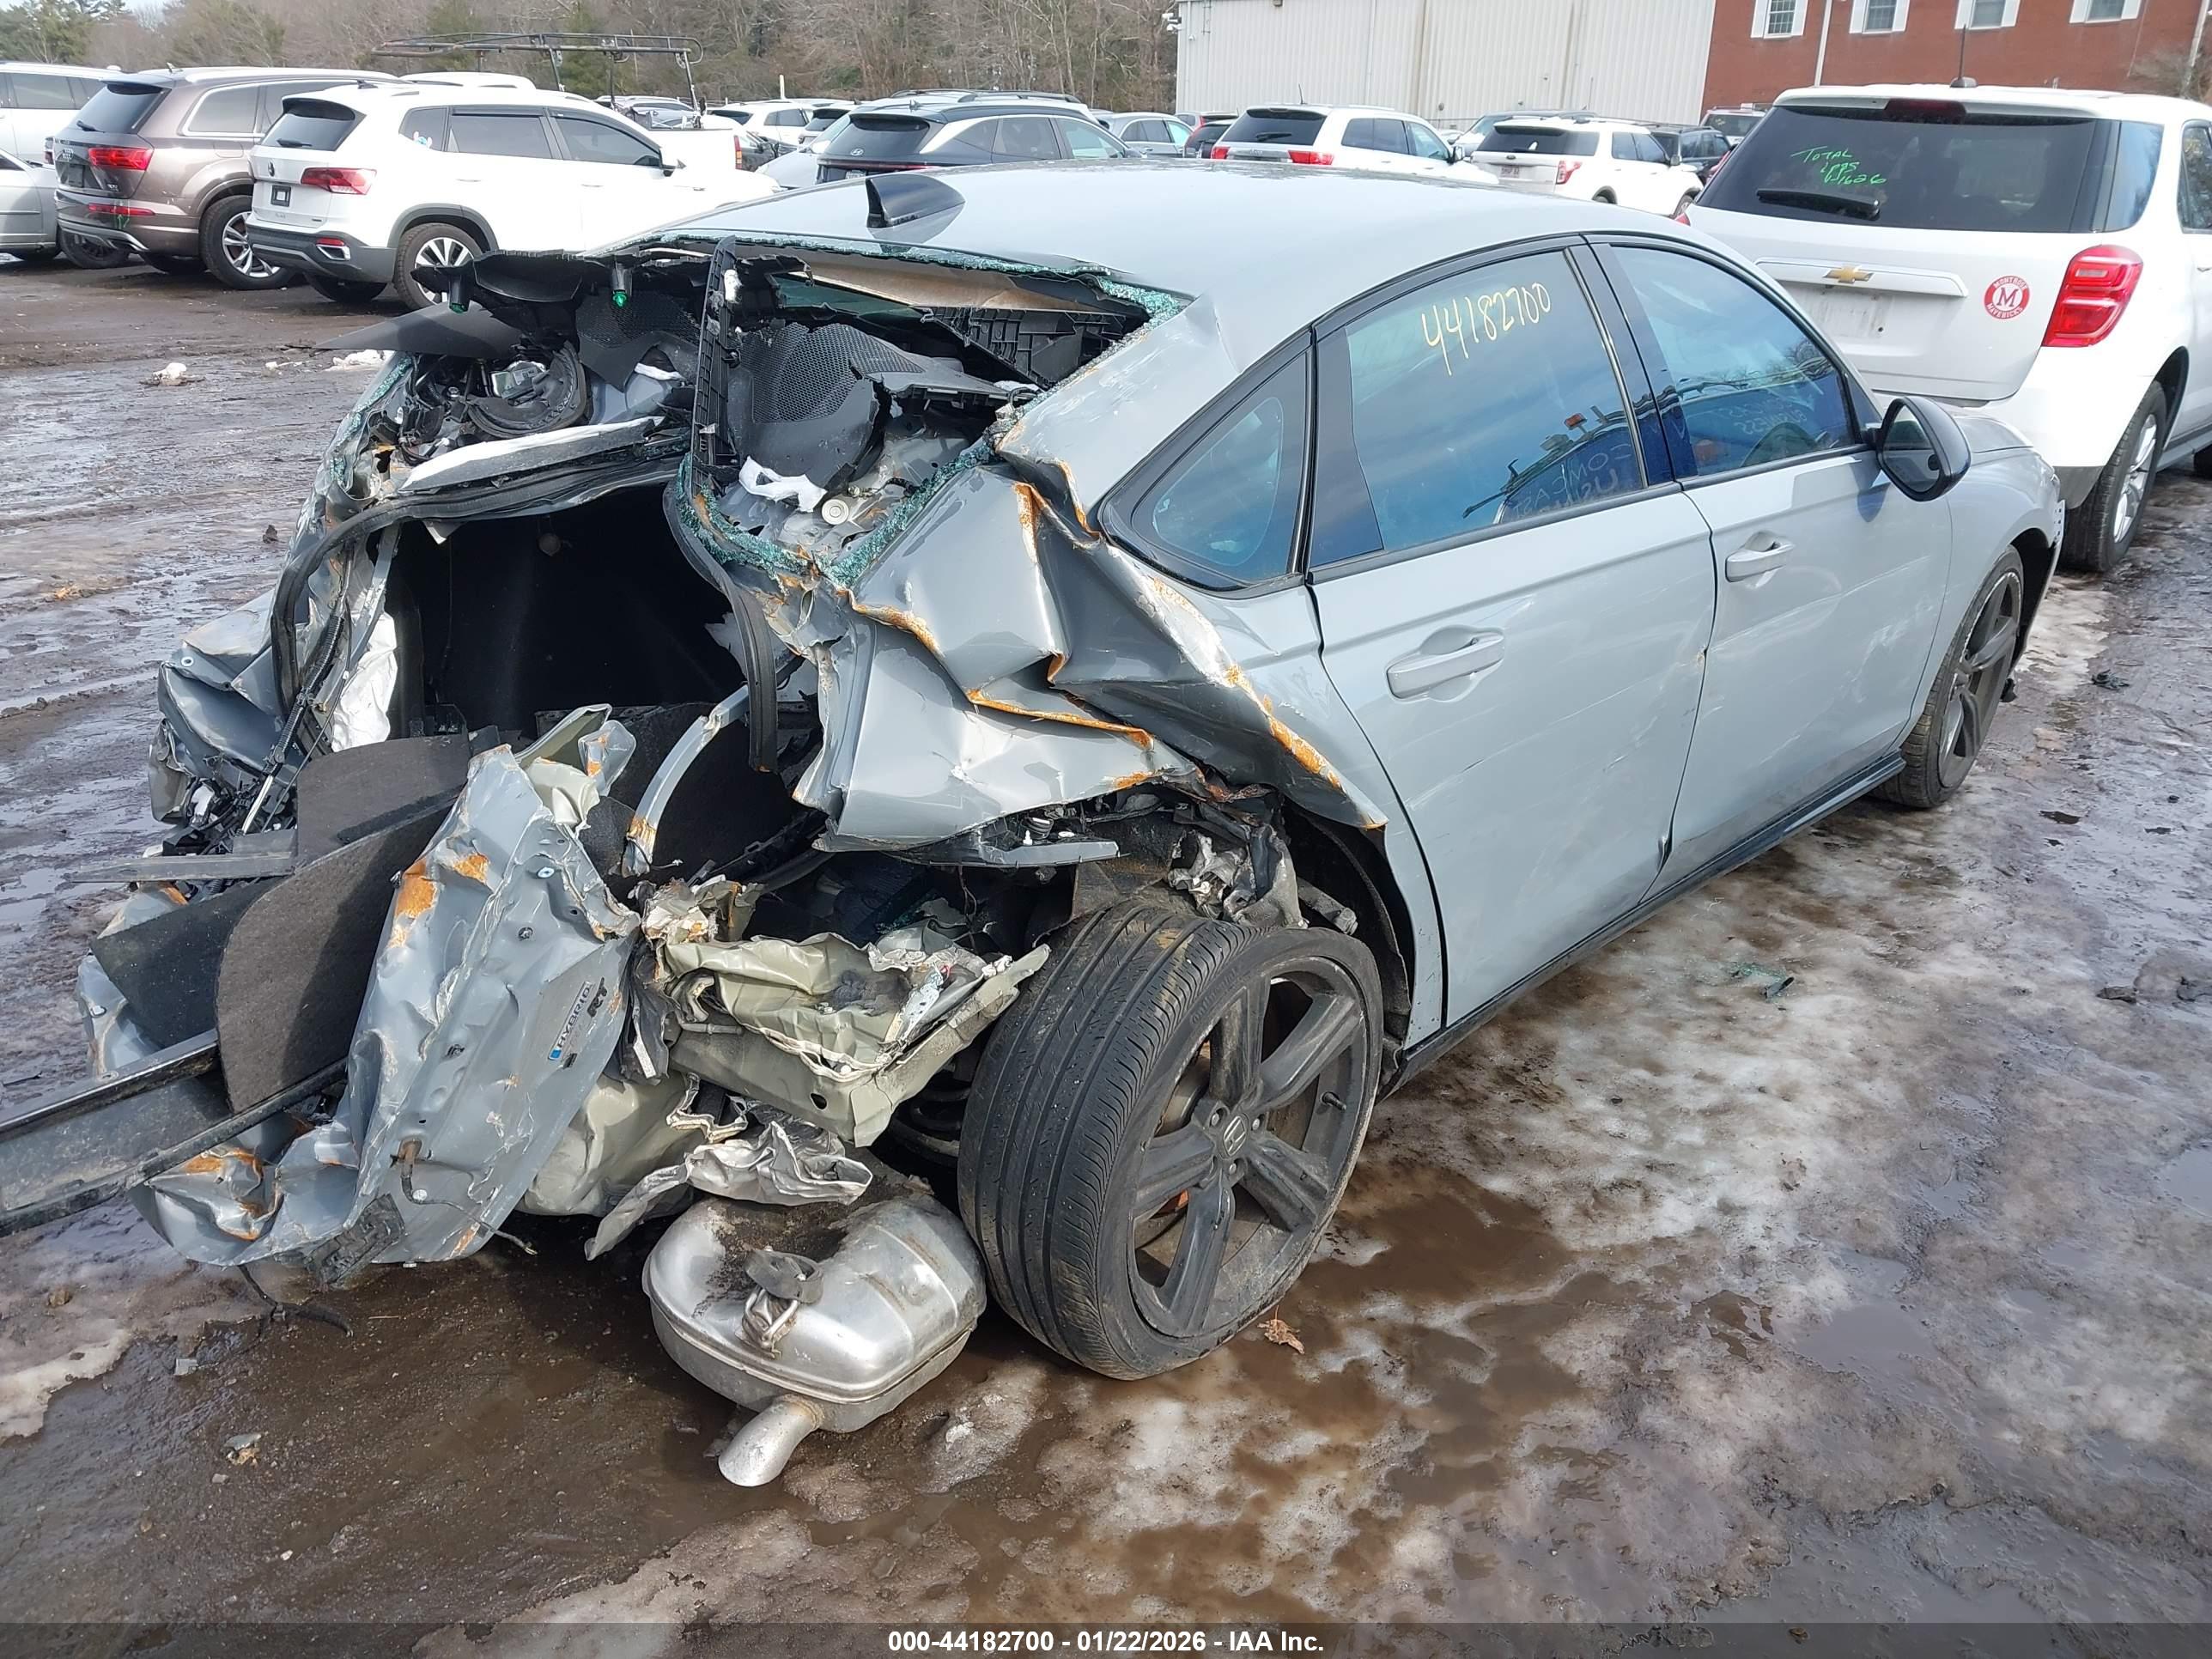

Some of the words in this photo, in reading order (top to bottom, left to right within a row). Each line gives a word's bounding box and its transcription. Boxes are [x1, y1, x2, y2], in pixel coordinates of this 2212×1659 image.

[1996, 287, 2020, 307] M
[1421, 282, 1551, 376] 44182700
[556, 987, 591, 1048] HYBRID
